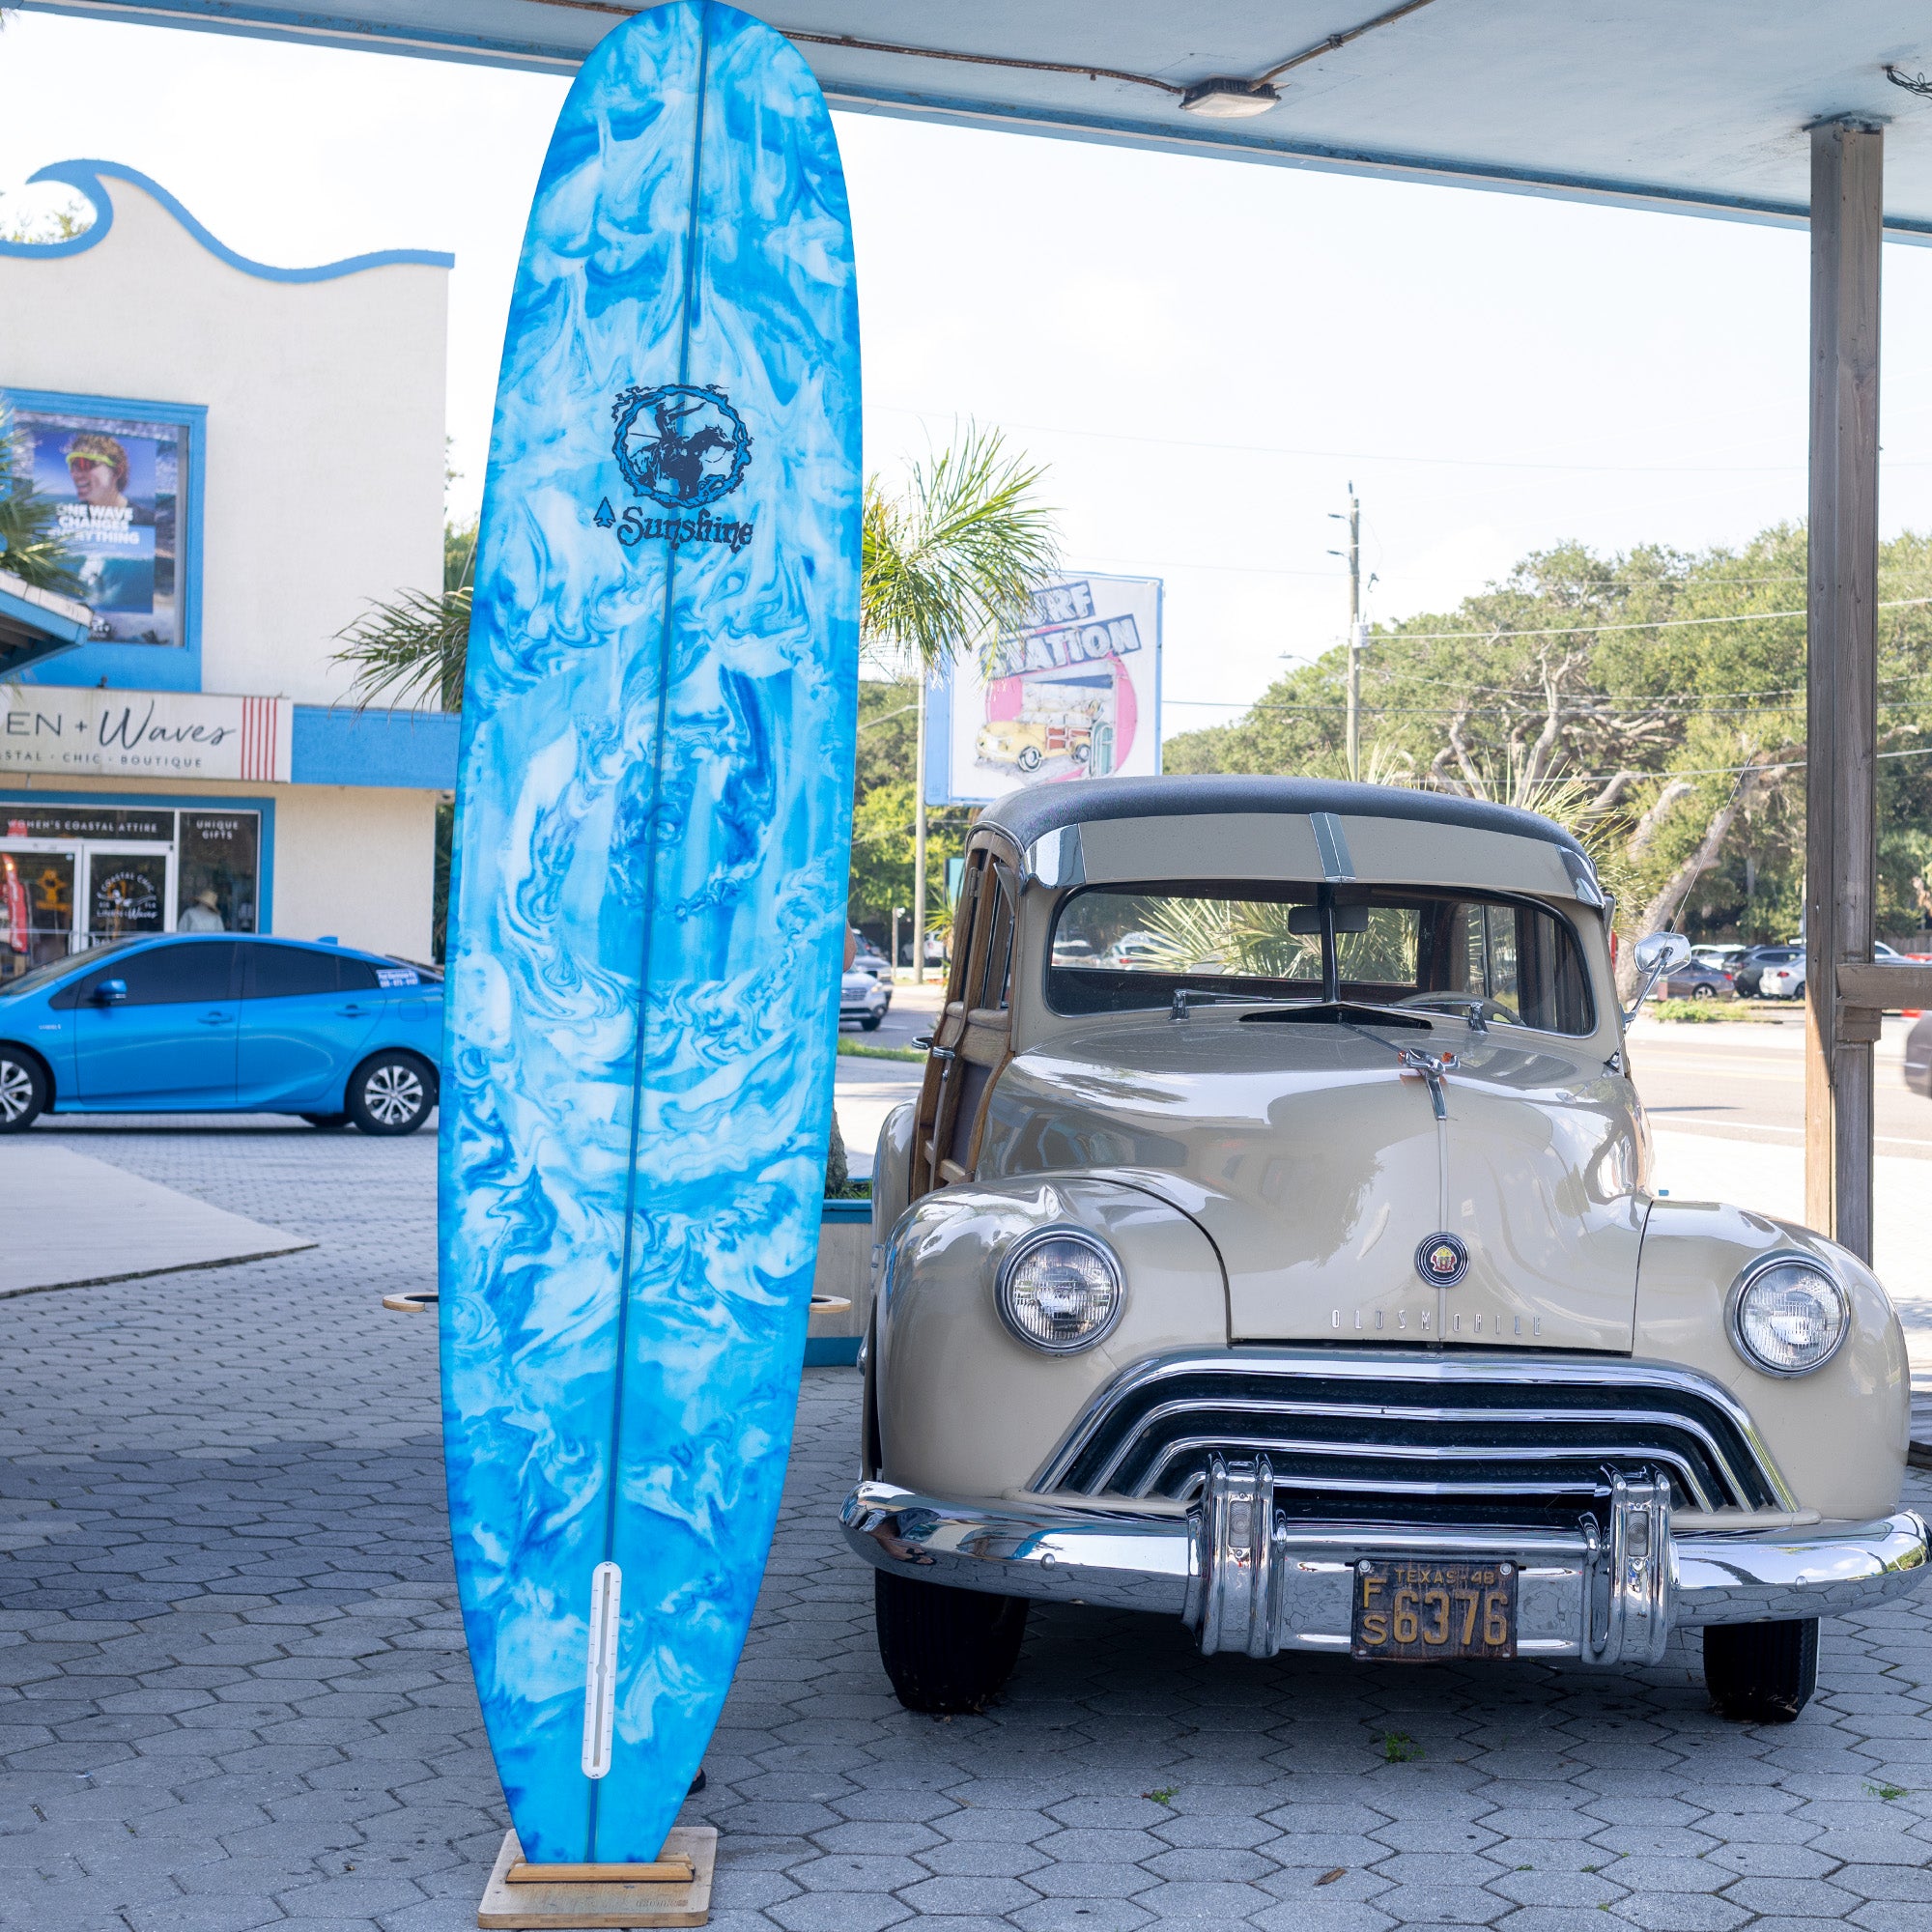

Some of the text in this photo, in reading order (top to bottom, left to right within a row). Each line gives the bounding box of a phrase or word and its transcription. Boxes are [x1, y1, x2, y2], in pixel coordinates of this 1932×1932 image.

[89, 504, 133, 522] WAVE
[59, 515, 129, 533] CHANGES
[617, 506, 753, 554] Sunshine
[1001, 583, 1091, 628] URF
[99, 699, 236, 751] Waves
[0, 749, 202, 769] STAL CHIC BOUTIQUE
[8, 819, 157, 834] WOMEN'S COASTAL ATTIRE
[196, 819, 239, 831] UNIQUE
[202, 830, 233, 840] GIFTS
[1331, 1309, 1543, 1336] OLDSMOBILE
[1393, 1589, 1508, 1646] 6376
